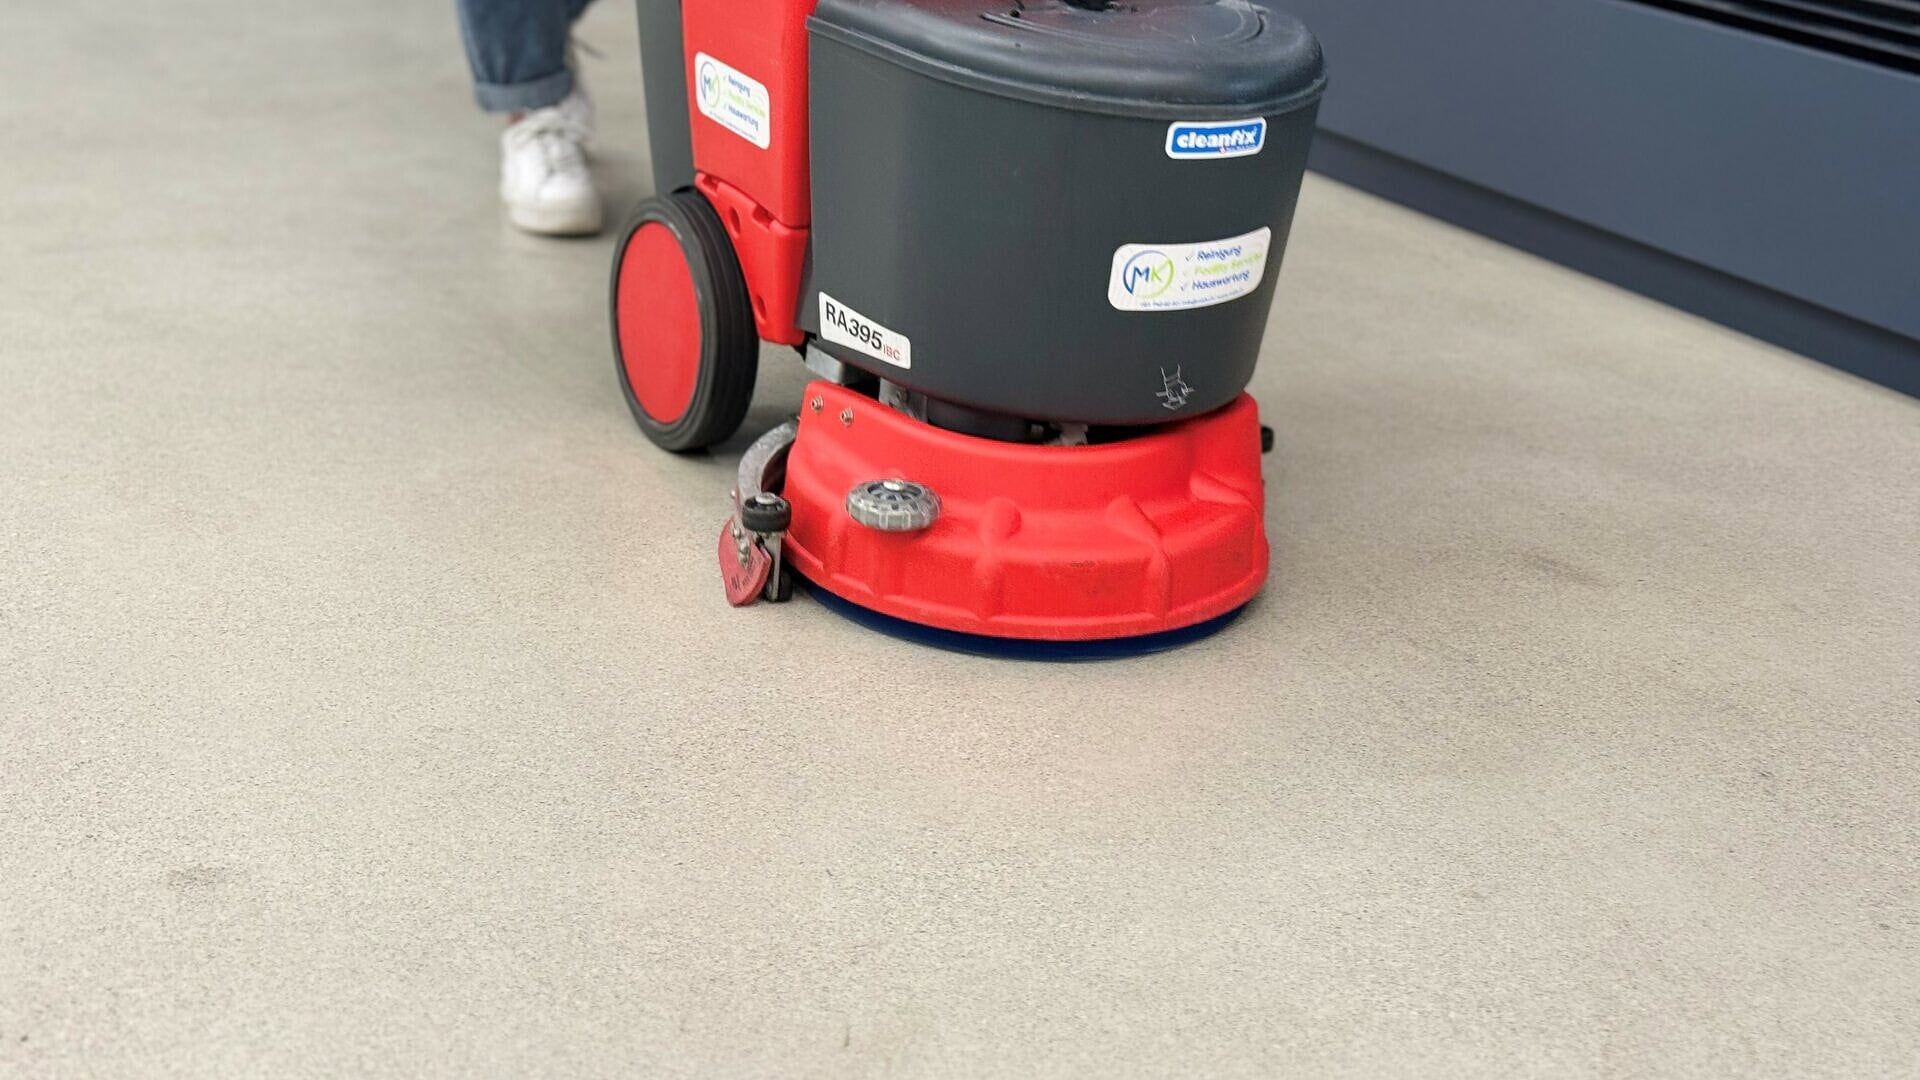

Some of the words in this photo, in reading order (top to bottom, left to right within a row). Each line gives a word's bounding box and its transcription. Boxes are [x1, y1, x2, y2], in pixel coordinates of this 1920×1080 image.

[1176, 128, 1256, 148] cleanfix
[825, 301, 883, 350] RA395
[883, 344, 902, 361] IBC
